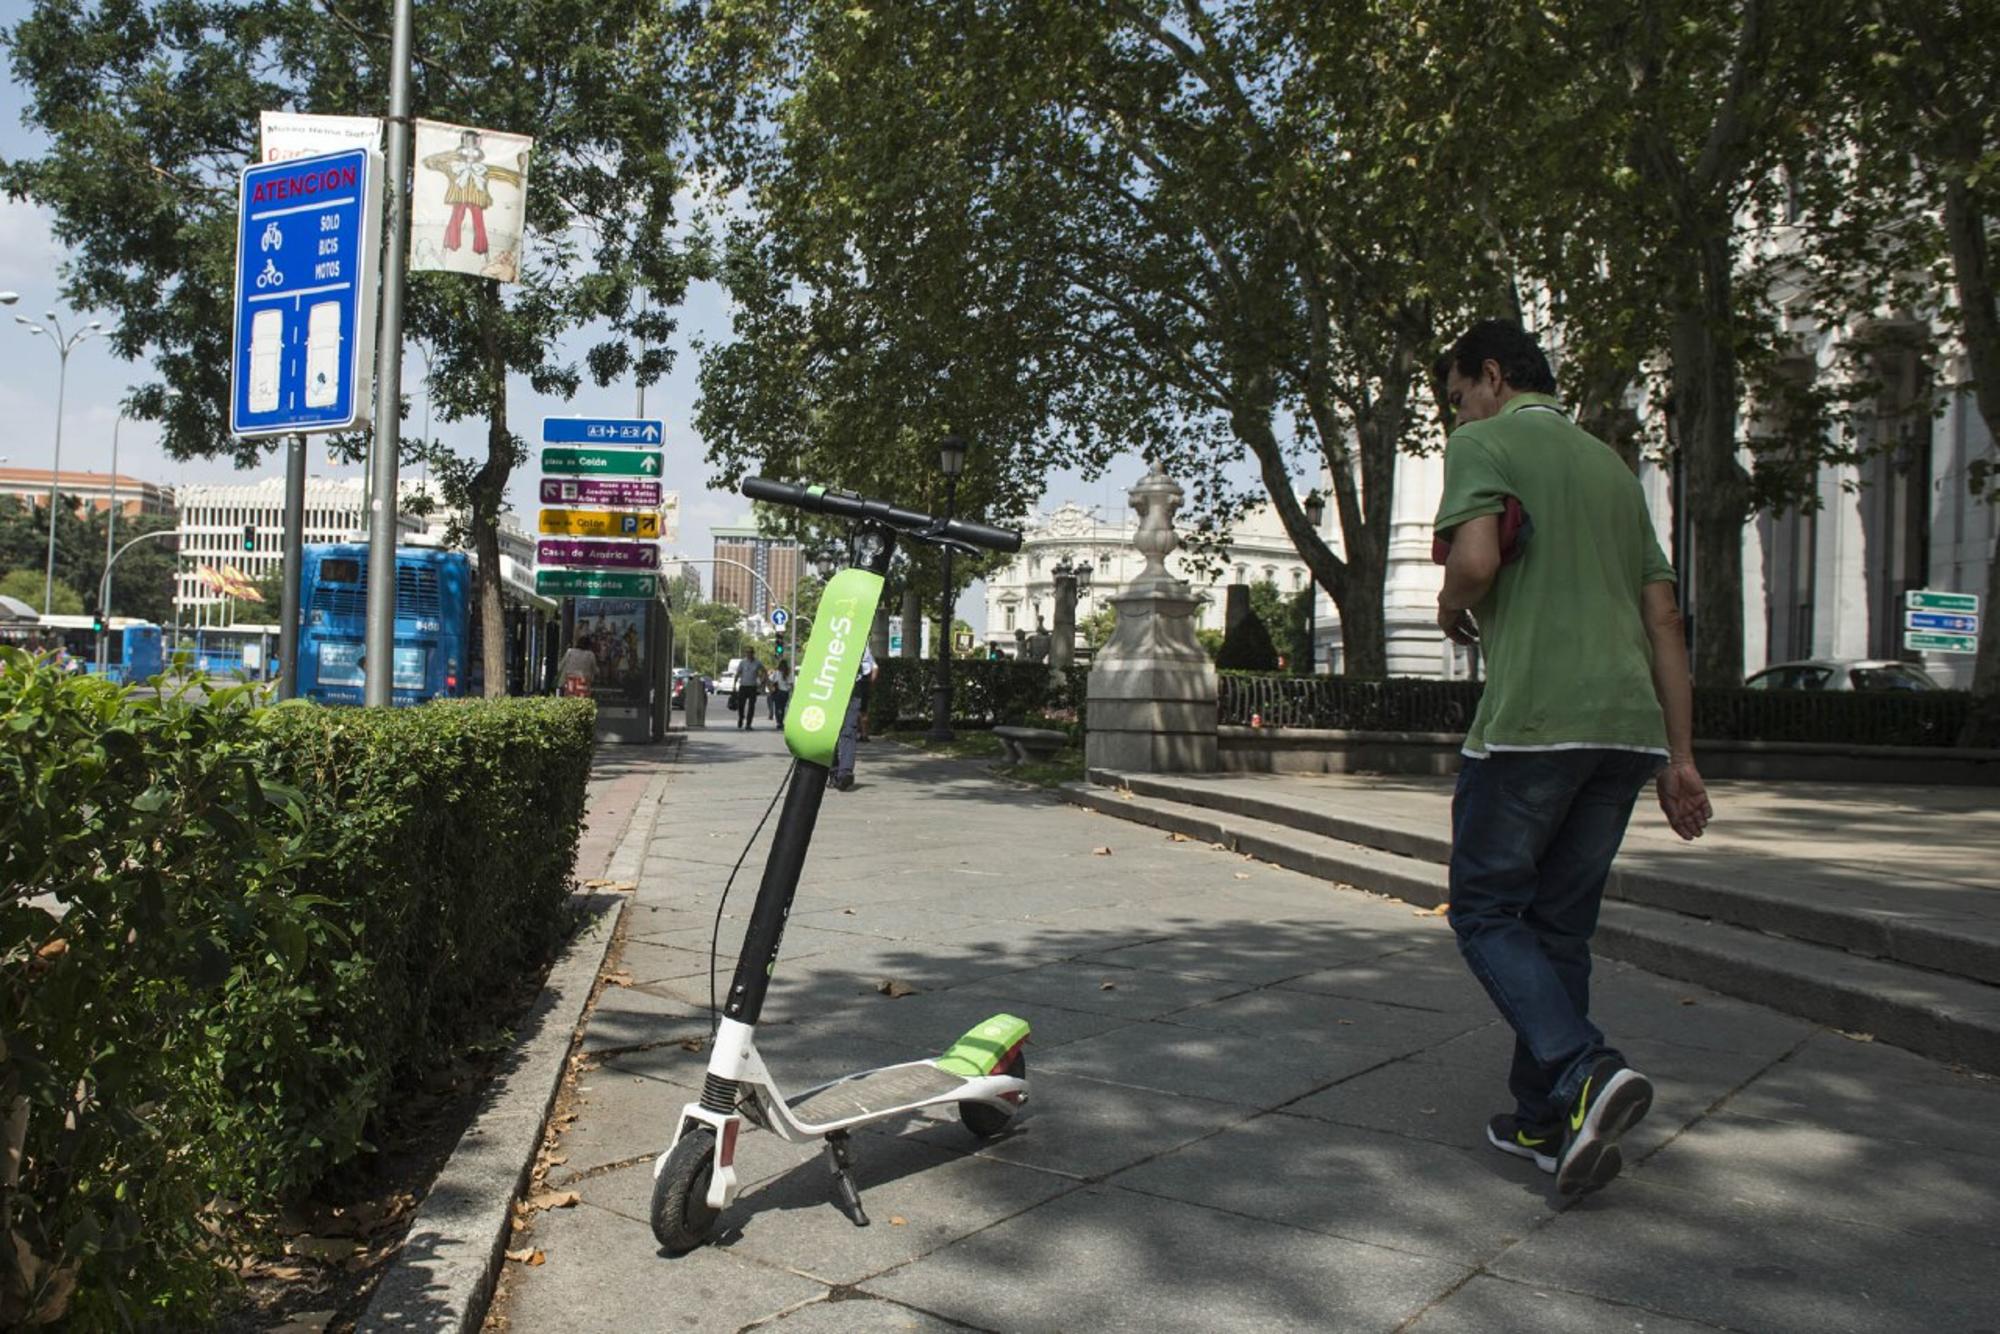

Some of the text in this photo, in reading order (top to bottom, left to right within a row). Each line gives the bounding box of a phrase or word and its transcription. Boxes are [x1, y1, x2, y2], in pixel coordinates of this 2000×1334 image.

[252, 166, 356, 205] ATENCION
[320, 213, 340, 232] SOLO
[318, 237, 338, 256] BICIS
[315, 260, 340, 280] MOTOS
[589, 426, 639, 437] A-1 A-2
[624, 517, 636, 532] P
[541, 547, 565, 557] Casa
[571, 548, 584, 558] de
